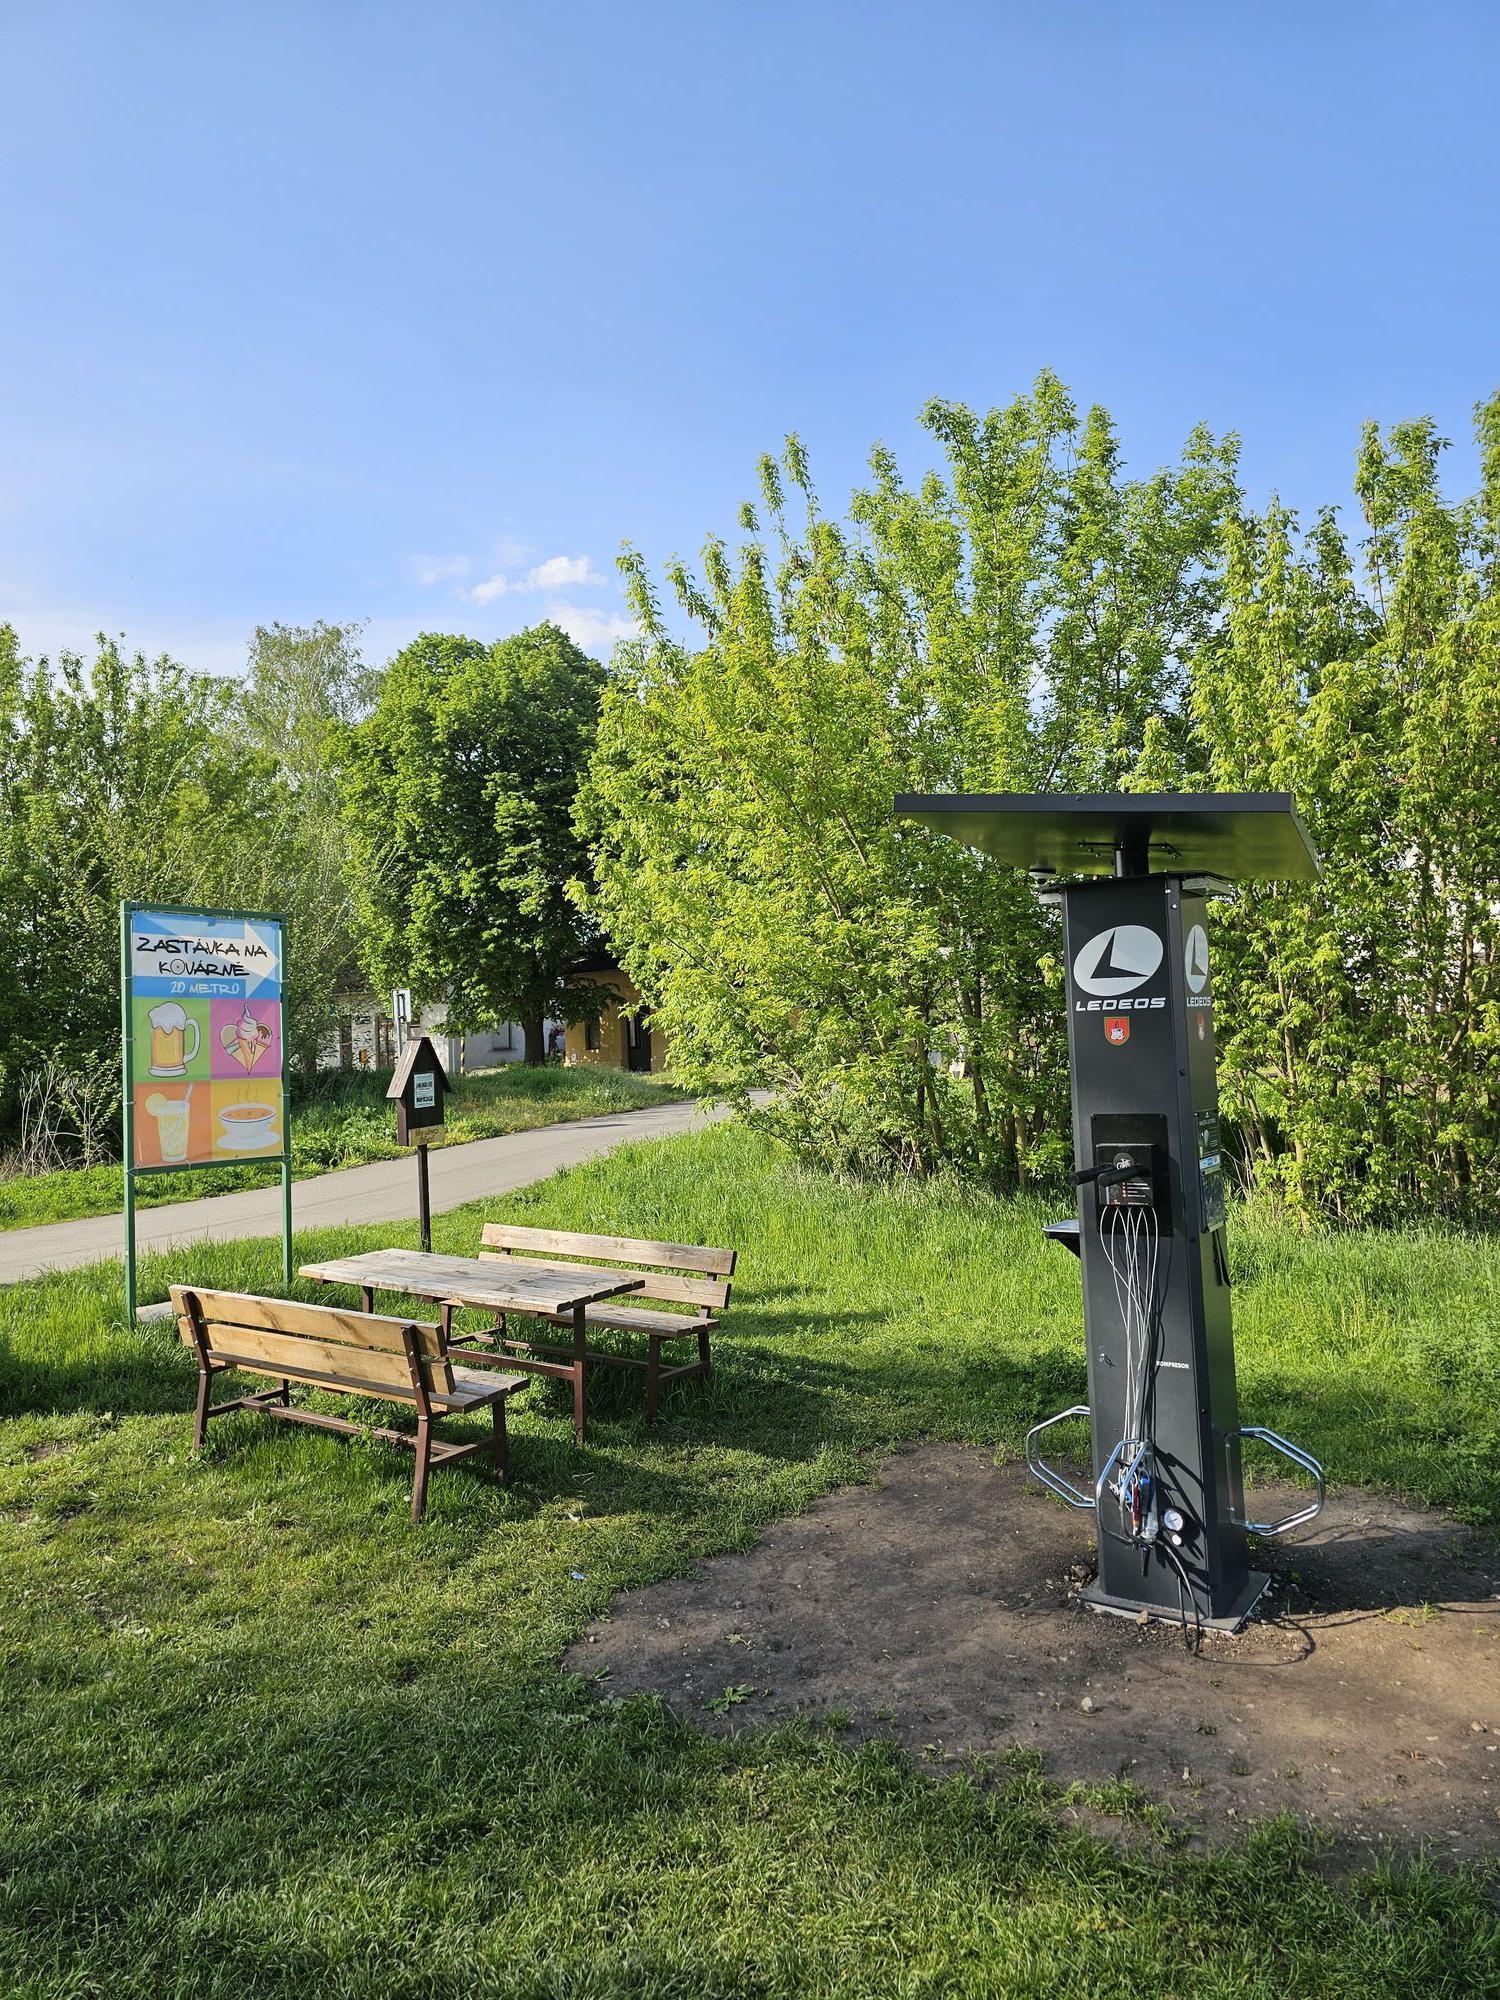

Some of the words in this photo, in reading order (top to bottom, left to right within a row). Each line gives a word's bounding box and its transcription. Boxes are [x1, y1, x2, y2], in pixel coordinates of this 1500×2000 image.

[136, 937, 240, 956] ZASTÁVKA
[244, 944, 268, 957] NA
[158, 959, 250, 976] KOVÁRNĚ
[170, 981, 185, 994] 20
[1076, 997, 1165, 1011] LEDEOS
[1186, 996, 1211, 1008] LEDEOS
